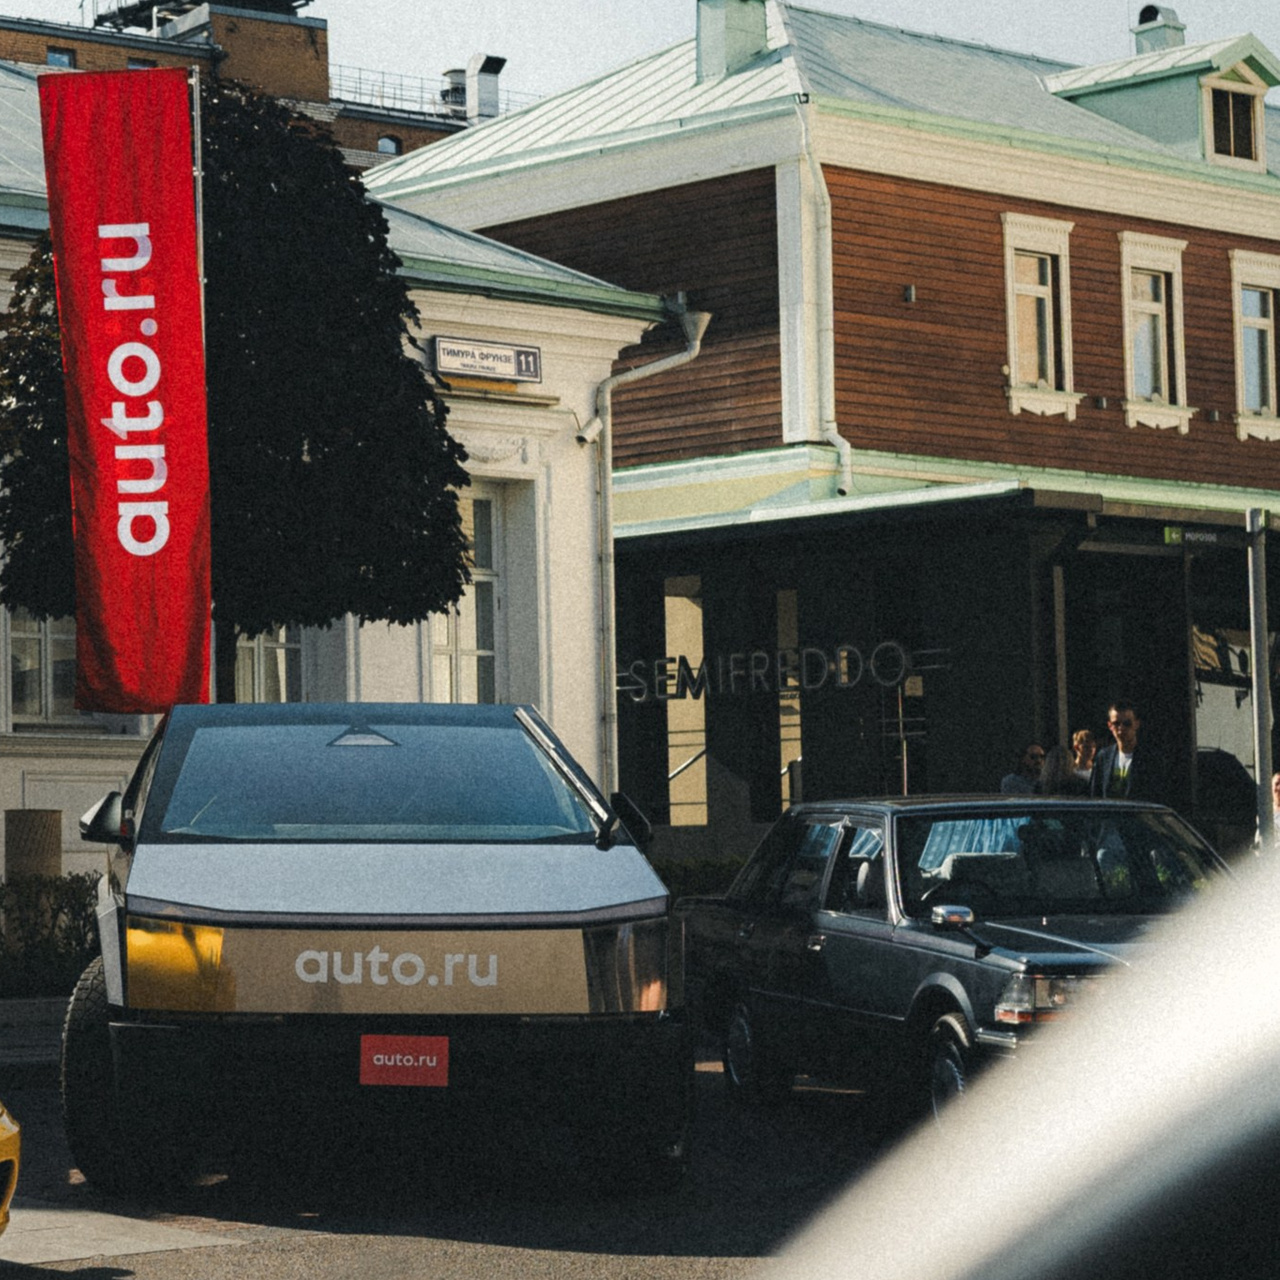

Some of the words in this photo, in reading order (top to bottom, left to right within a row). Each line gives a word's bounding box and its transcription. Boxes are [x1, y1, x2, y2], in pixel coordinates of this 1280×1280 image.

[442, 347, 477, 360] ТИМУРА
[479, 351, 514, 364] ФРУНЗЕ
[520, 354, 534, 372] 11
[98, 223, 170, 556] auto.ru
[629, 641, 906, 702] SEMIFREDDO
[294, 945, 498, 987] auto.ru
[372, 1051, 438, 1068] auto.ru
